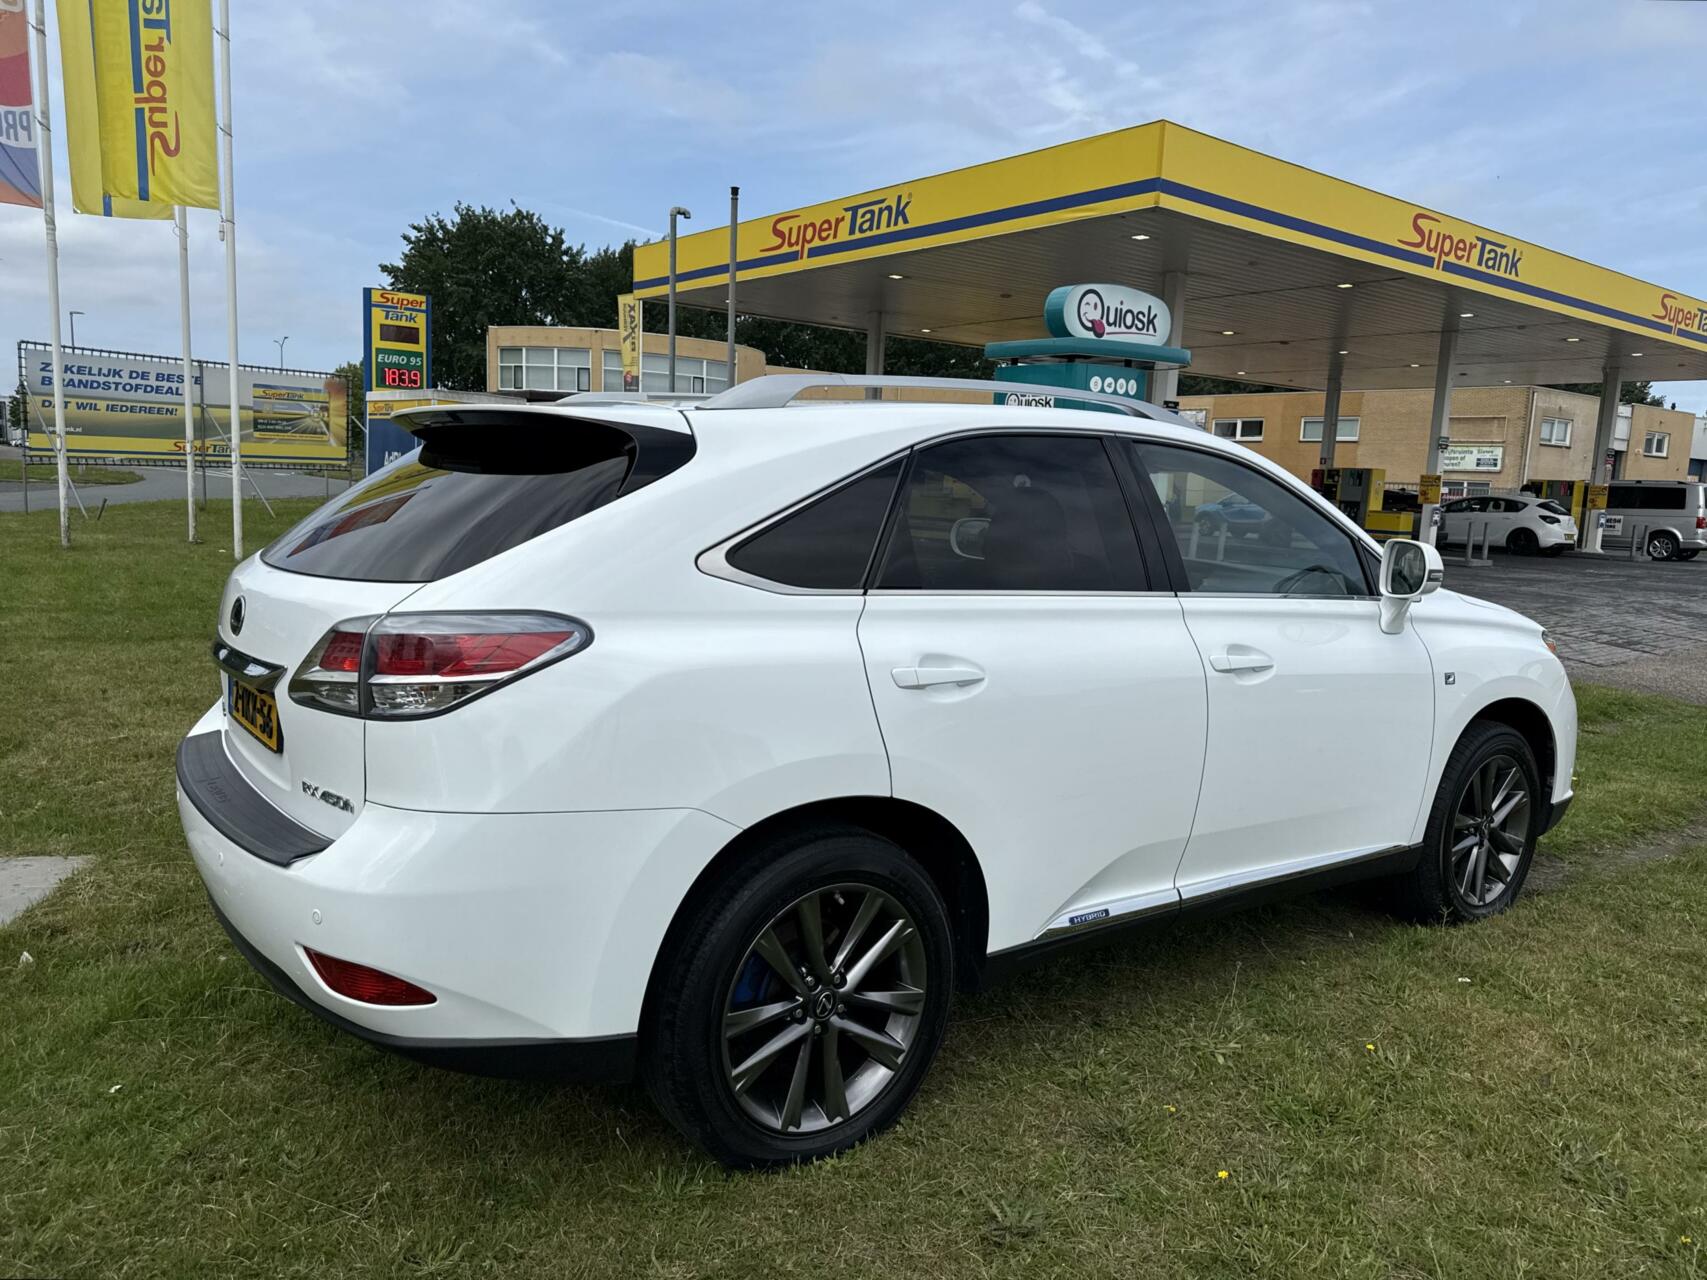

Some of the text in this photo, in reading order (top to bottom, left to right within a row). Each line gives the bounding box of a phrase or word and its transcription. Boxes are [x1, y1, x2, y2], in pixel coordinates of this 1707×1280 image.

[760, 194, 912, 260] SuperTank
[1397, 213, 1522, 277] SuperTank
[372, 292, 426, 310] Super
[381, 309, 418, 324] Tank
[1077, 288, 1158, 338] Quiosk
[377, 354, 422, 366] EURO 95
[40, 362, 202, 385] ZKELIJK DE BESE
[42, 399, 178, 416] DT WIL IEDEREEN!
[1073, 910, 1106, 924] HYBRID
